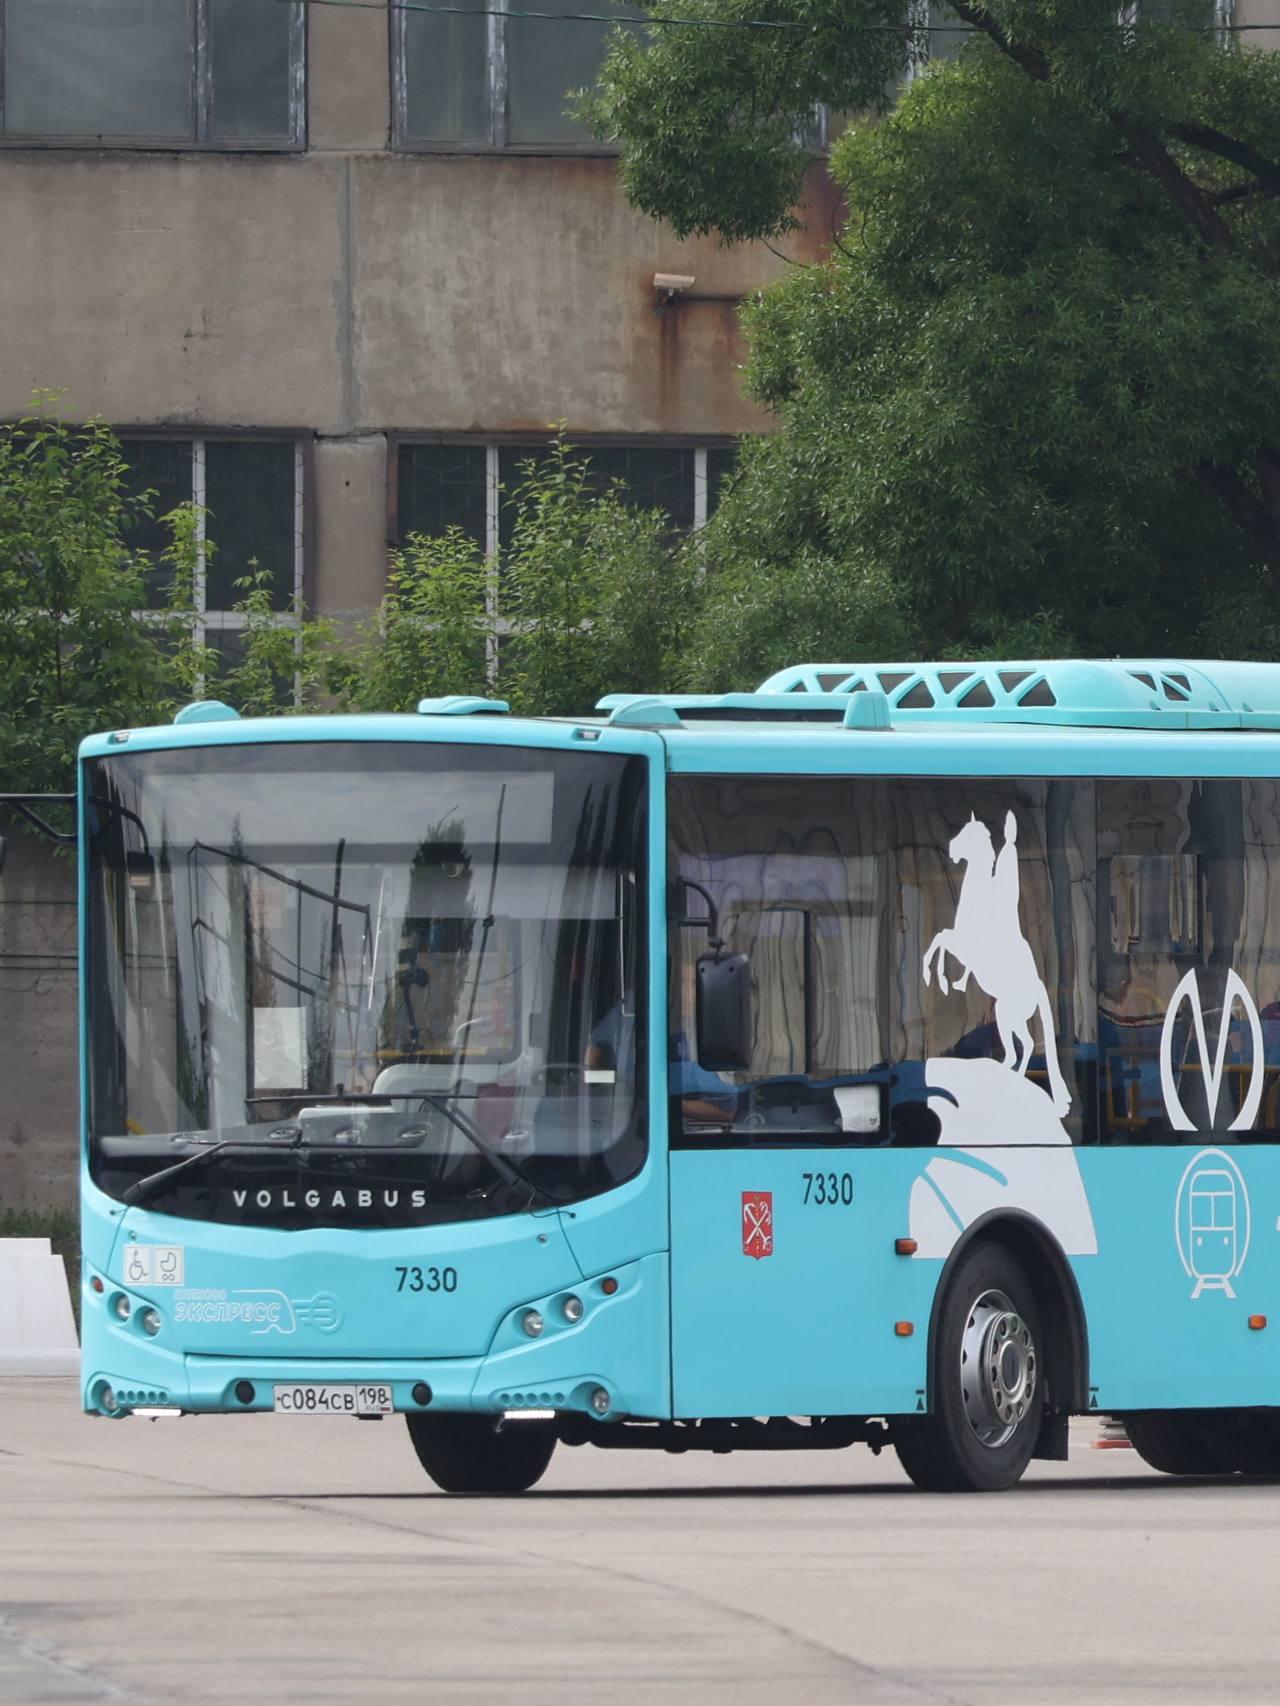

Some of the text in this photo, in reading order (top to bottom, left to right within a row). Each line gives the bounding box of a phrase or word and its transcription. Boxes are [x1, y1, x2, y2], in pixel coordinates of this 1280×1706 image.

[232, 1190, 427, 1208] VOLGABUS
[802, 1172, 853, 1206] 7330
[395, 1266, 458, 1293] 7330
[174, 1302, 281, 1322] ЭКСПРЕСС
[280, 1387, 387, 1411] С084СВ 198
